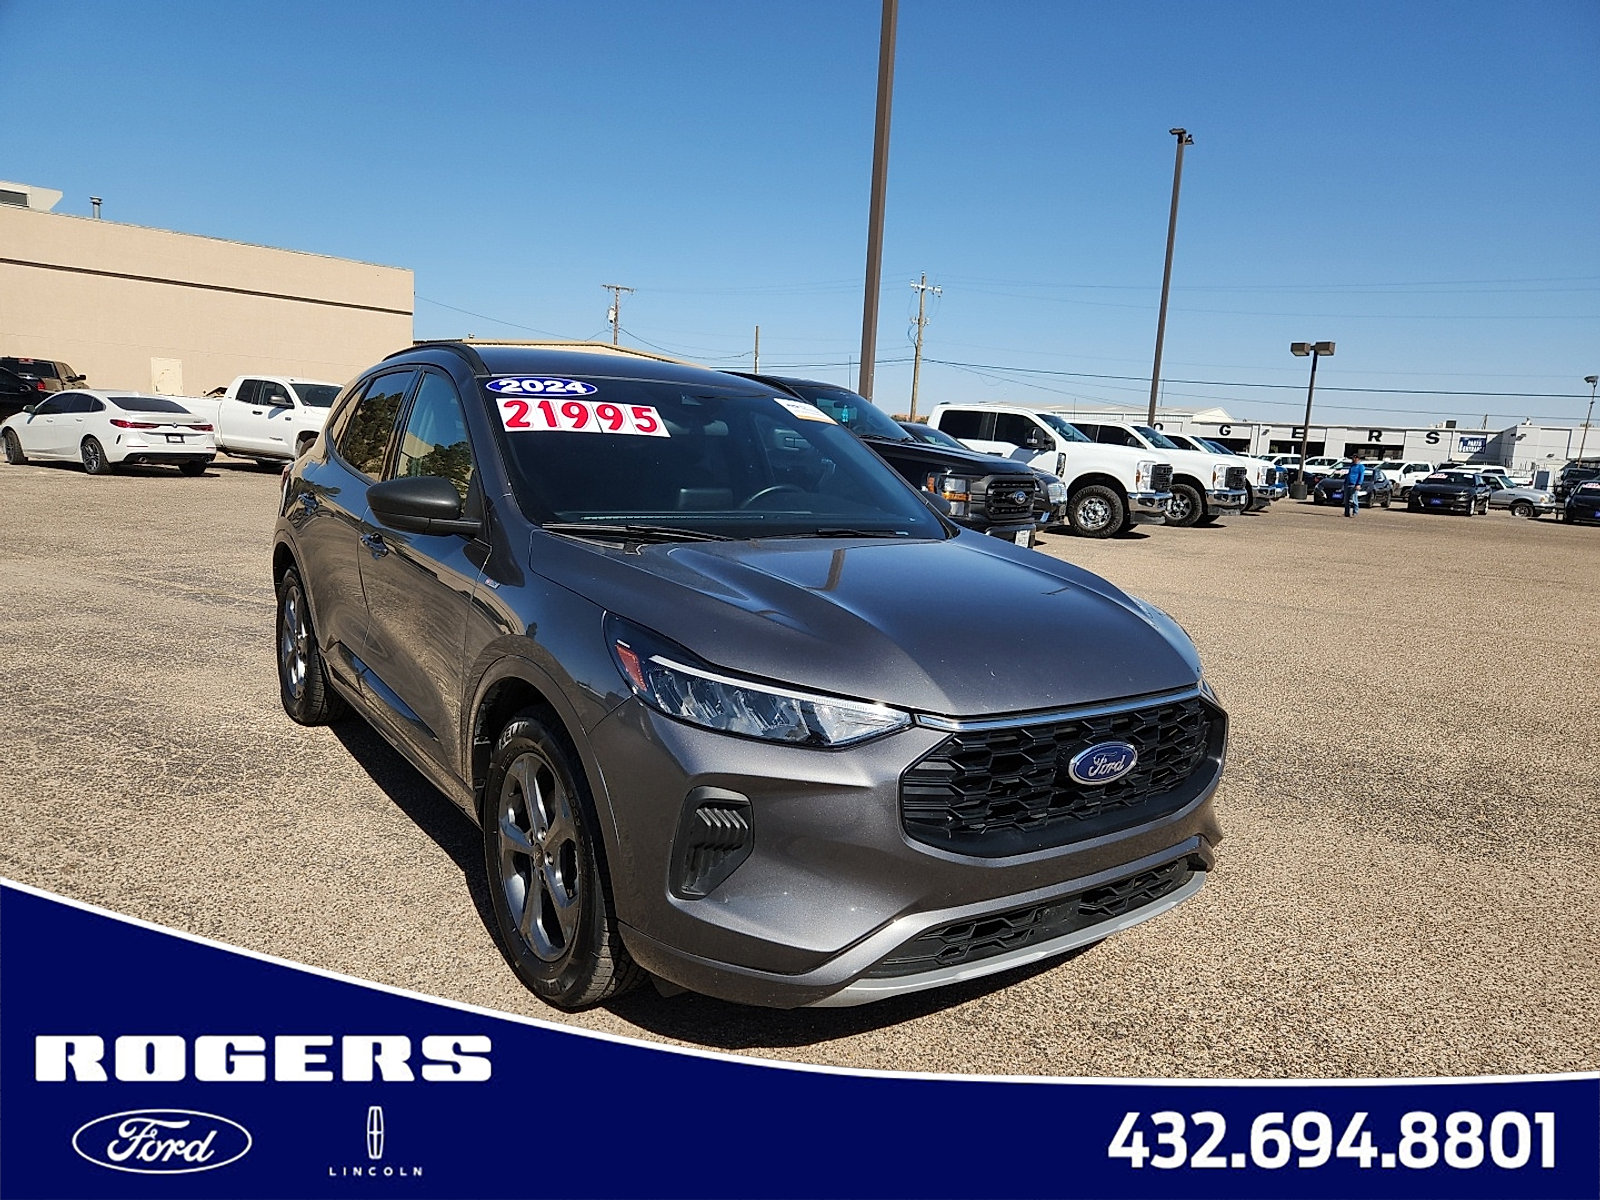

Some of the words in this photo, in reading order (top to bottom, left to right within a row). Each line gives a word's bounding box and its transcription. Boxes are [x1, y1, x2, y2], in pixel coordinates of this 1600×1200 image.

[499, 380, 588, 394] 2024
[503, 400, 658, 433] 21995
[1088, 752, 1126, 777] Ford
